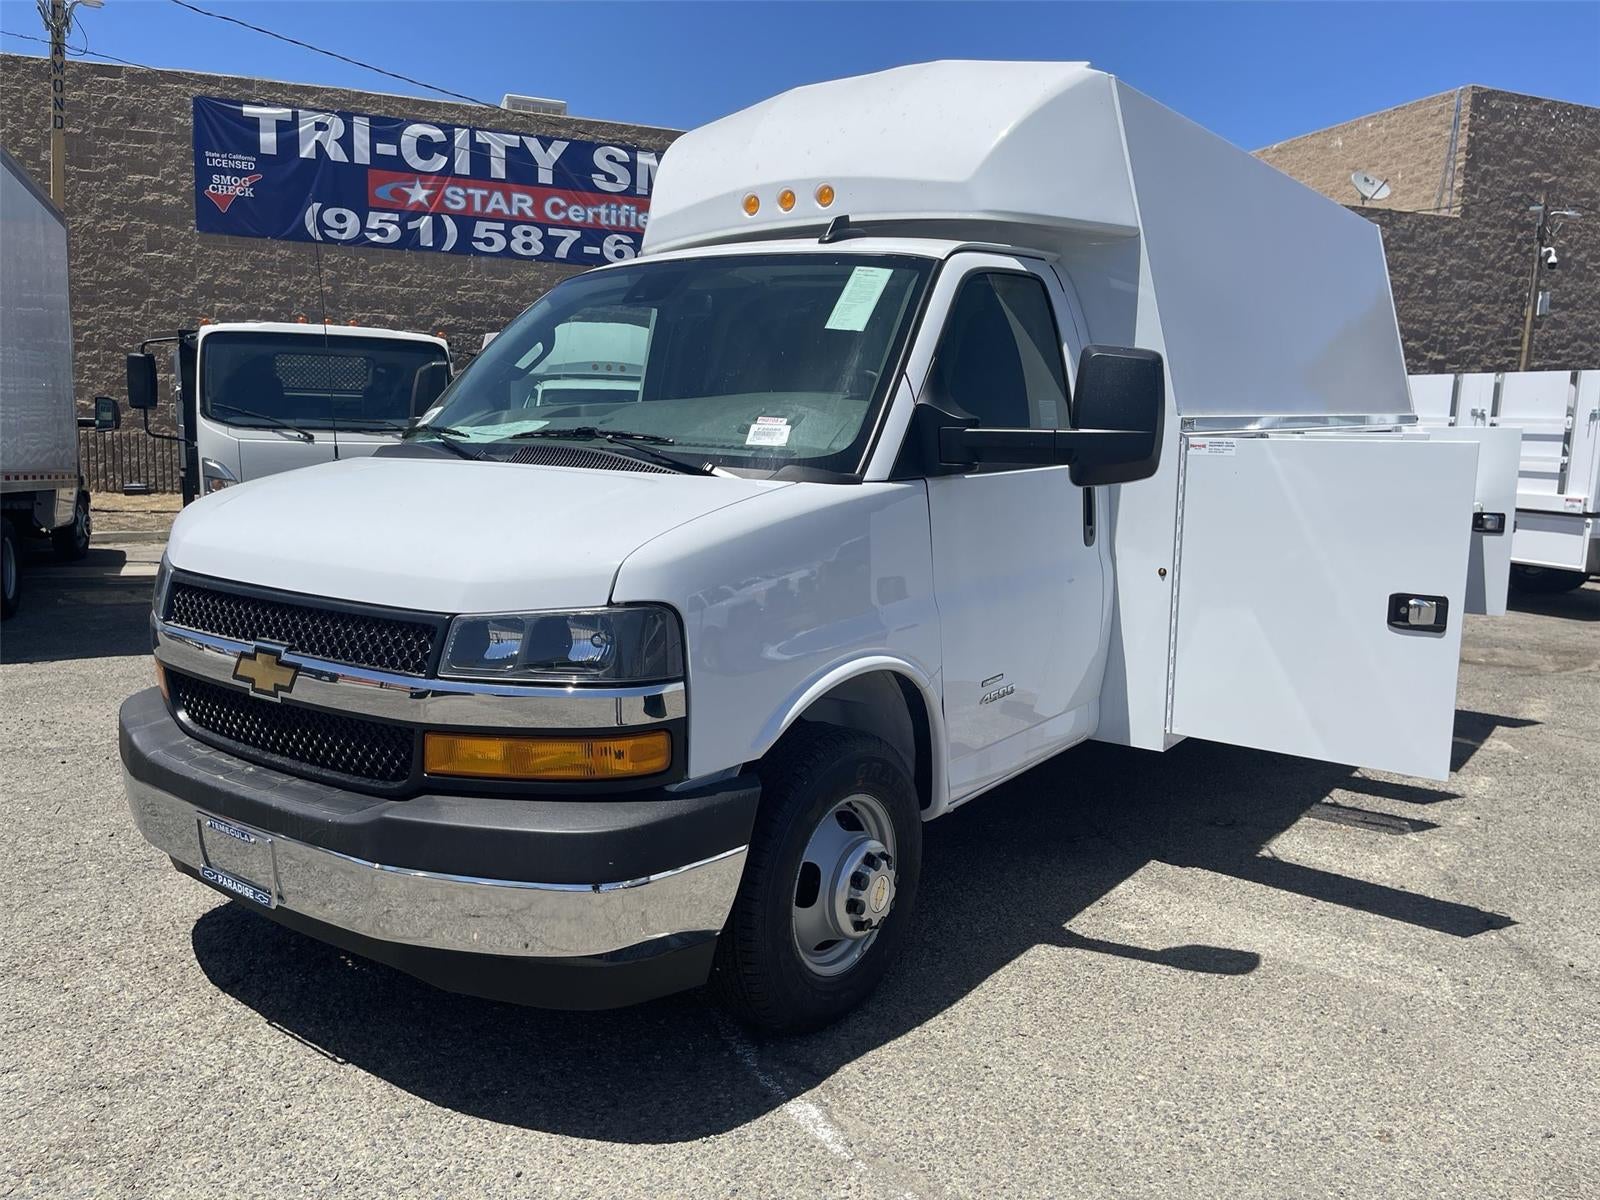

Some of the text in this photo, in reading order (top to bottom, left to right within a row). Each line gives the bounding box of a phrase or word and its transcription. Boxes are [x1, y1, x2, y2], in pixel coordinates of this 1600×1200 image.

[242, 104, 568, 185] TRI-CITY
[206, 158, 255, 171] LICENSED
[228, 153, 256, 162] California
[208, 184, 255, 198] CHECK
[212, 174, 250, 187] SMOG
[444, 186, 536, 218] STAR
[304, 202, 643, 263] (951) 587-6
[210, 820, 251, 843] TEMECULA
[217, 874, 254, 898] PARADISE
